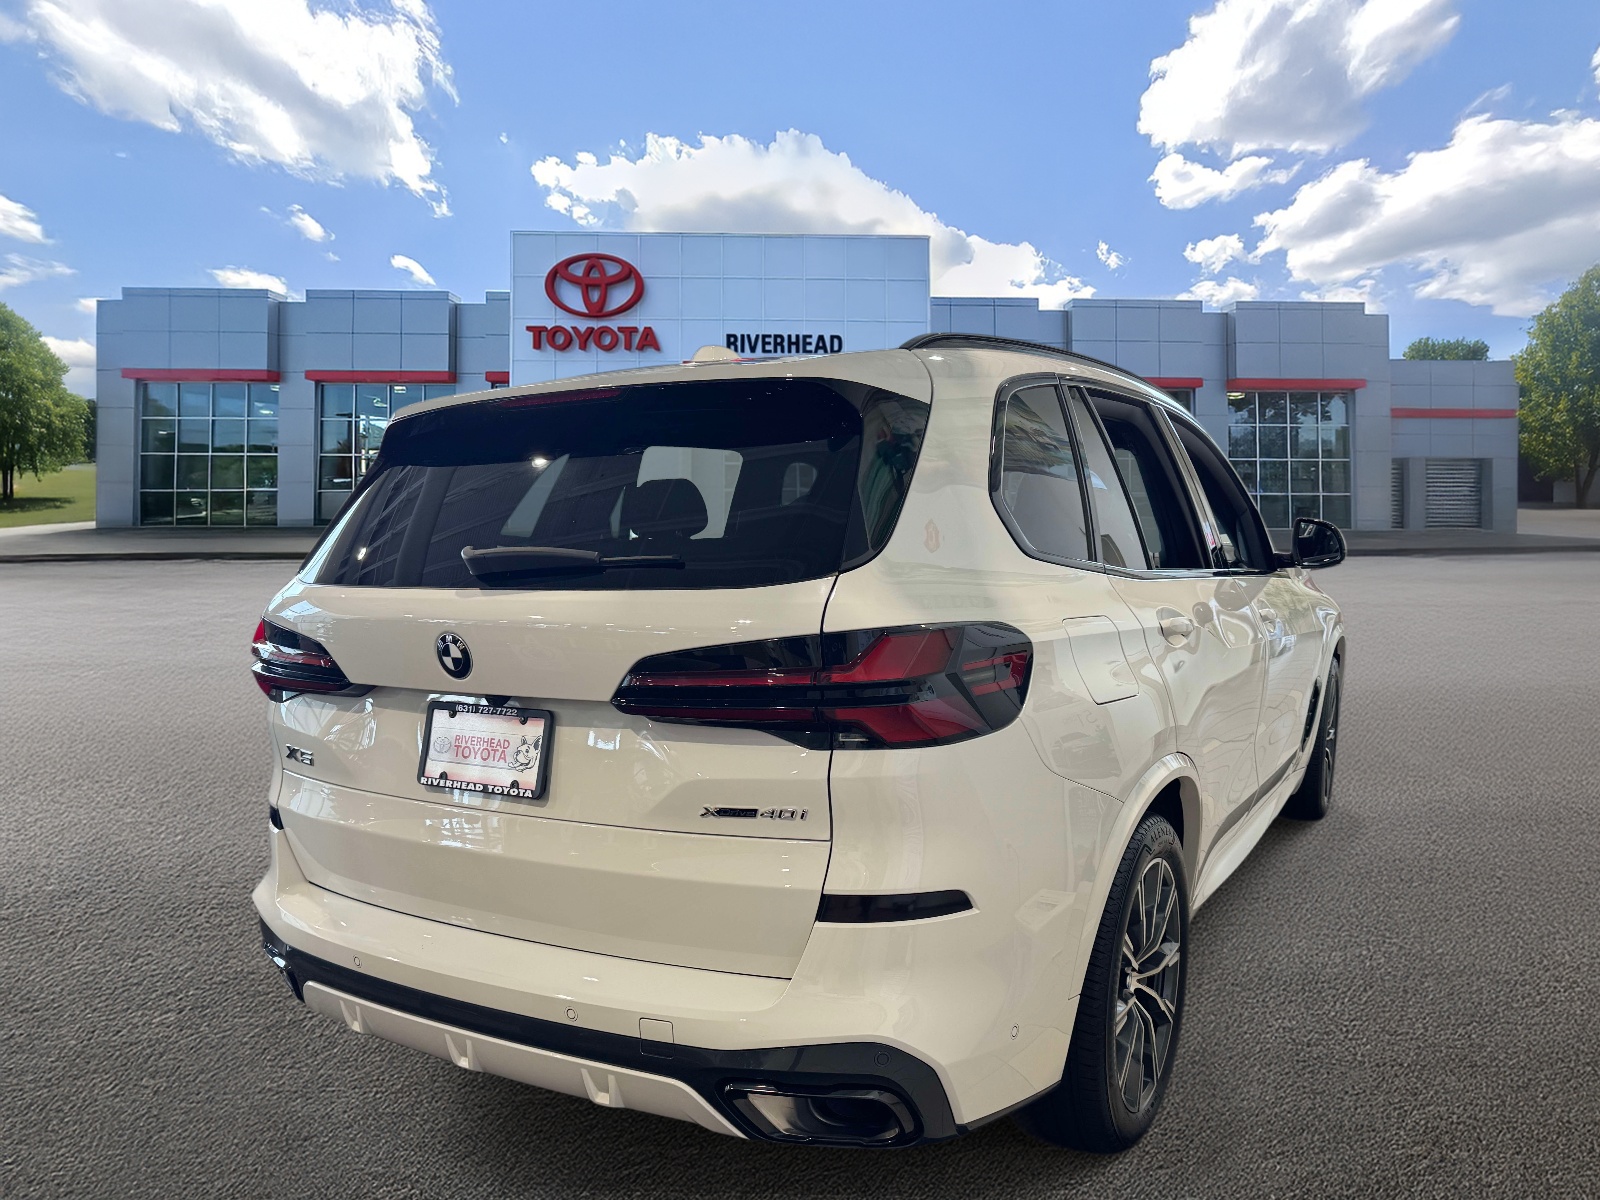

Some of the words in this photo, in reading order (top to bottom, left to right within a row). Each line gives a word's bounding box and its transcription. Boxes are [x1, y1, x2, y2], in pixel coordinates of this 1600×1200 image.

[526, 325, 661, 352] TOYOTA
[725, 333, 844, 354] RIVERHEAD
[455, 704, 475, 713] (631)
[478, 706, 517, 716] 727-7722
[454, 734, 510, 749] RIVERHEAD
[285, 743, 315, 767] X5
[454, 745, 507, 763] TOYOTA
[420, 777, 483, 791] RIVERHEAD
[488, 785, 532, 798] TOYOTA
